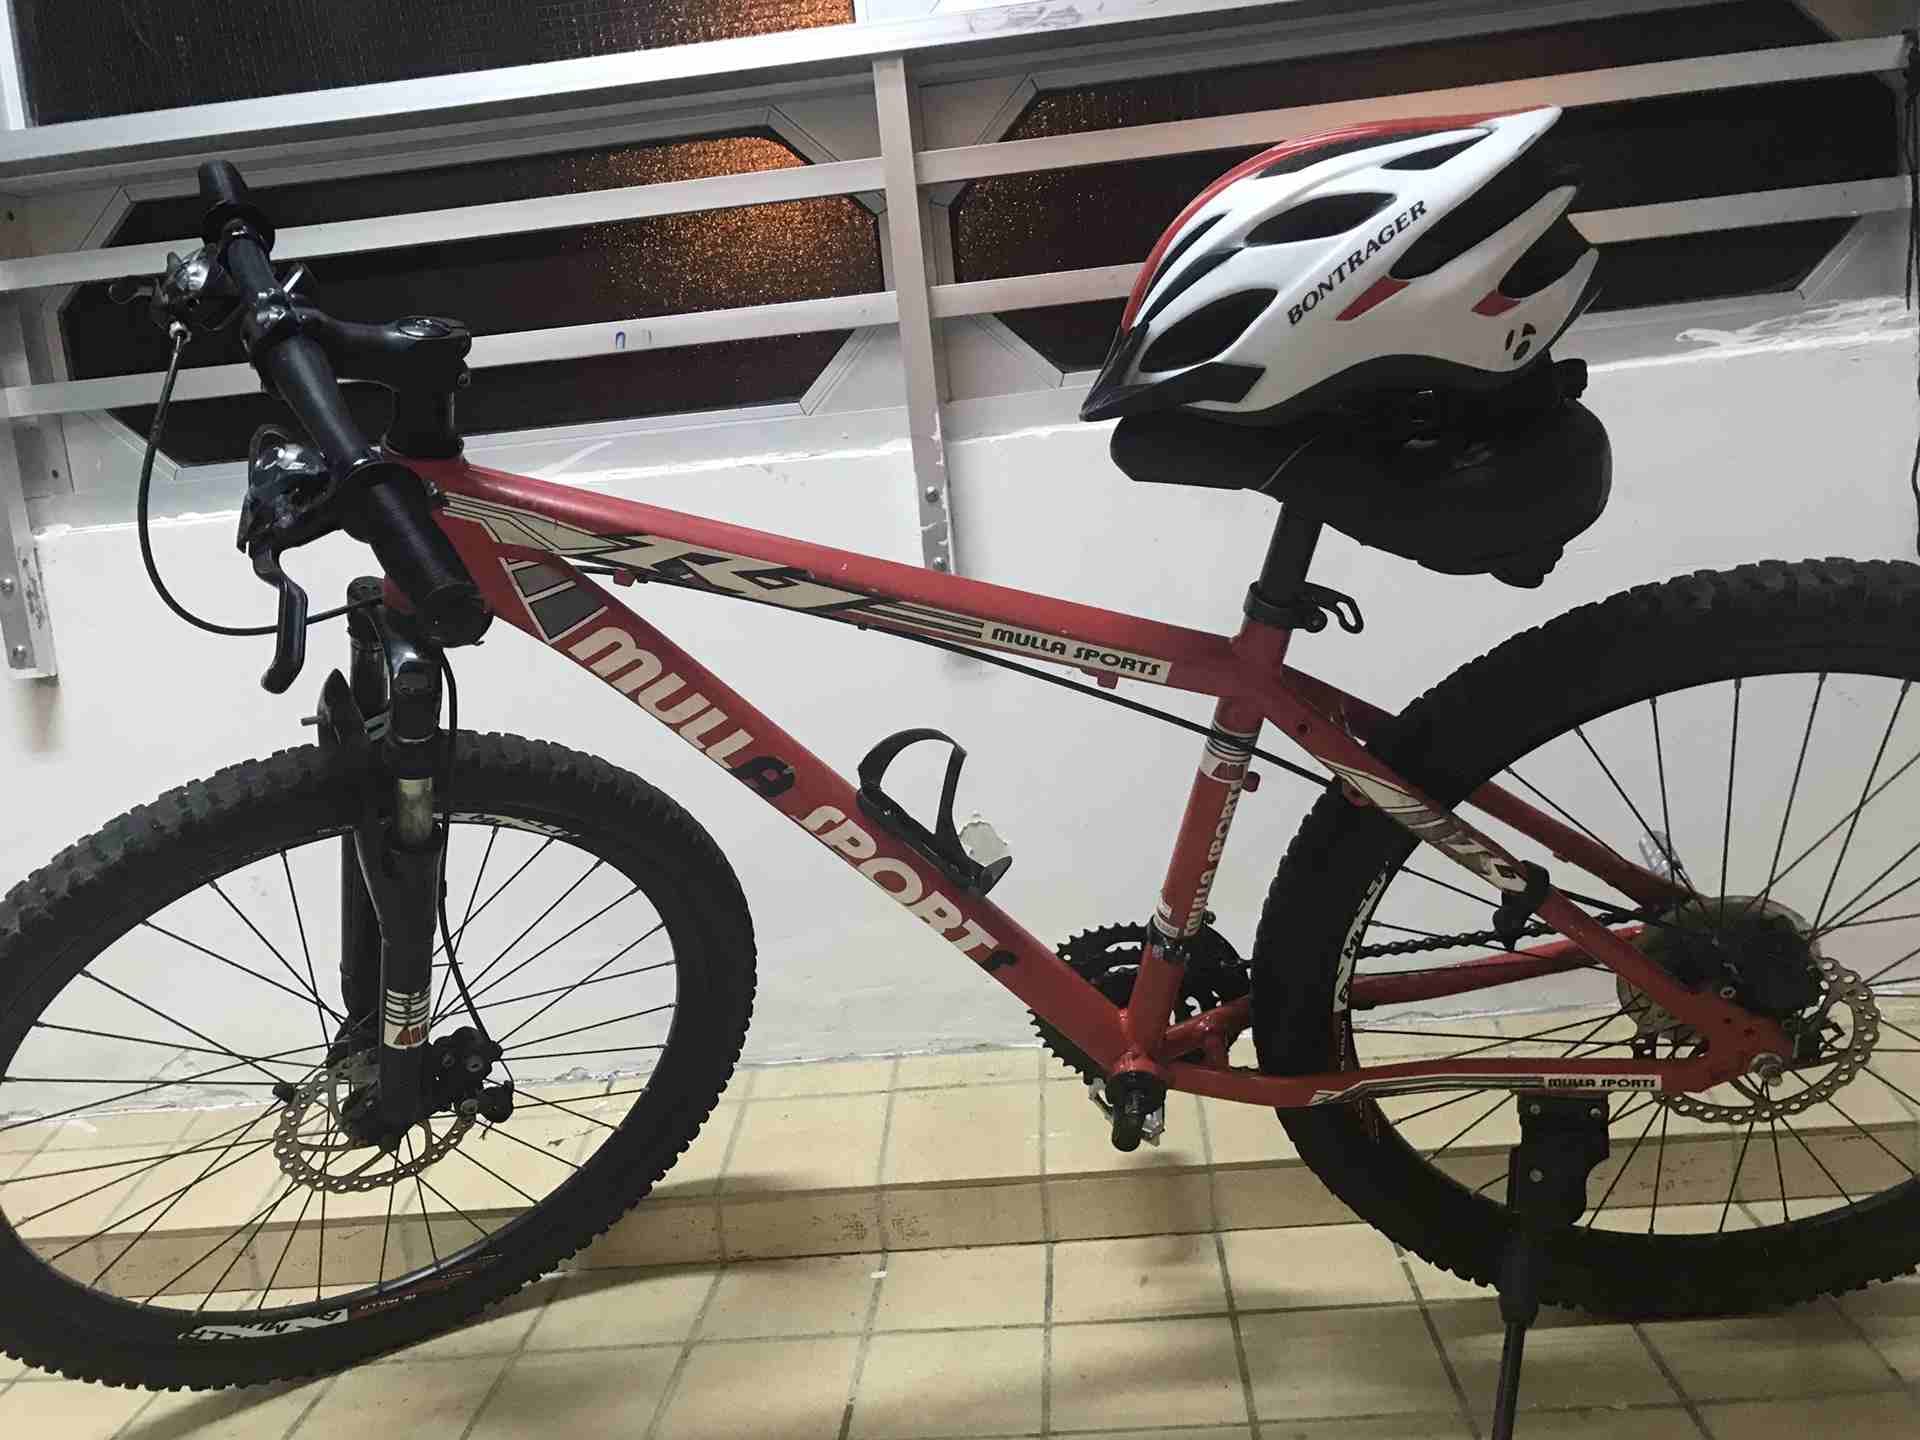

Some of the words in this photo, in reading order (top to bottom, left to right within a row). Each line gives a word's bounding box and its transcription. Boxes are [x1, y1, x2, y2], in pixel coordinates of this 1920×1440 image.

[1287, 200, 1428, 327] BONTRAGER
[992, 627, 1067, 656] MULLA
[1072, 646, 1161, 676] SPORTS
[568, 625, 796, 800] MULLA
[1547, 1078, 1596, 1089] MULLA
[1600, 1078, 1656, 1089] SPORTS
